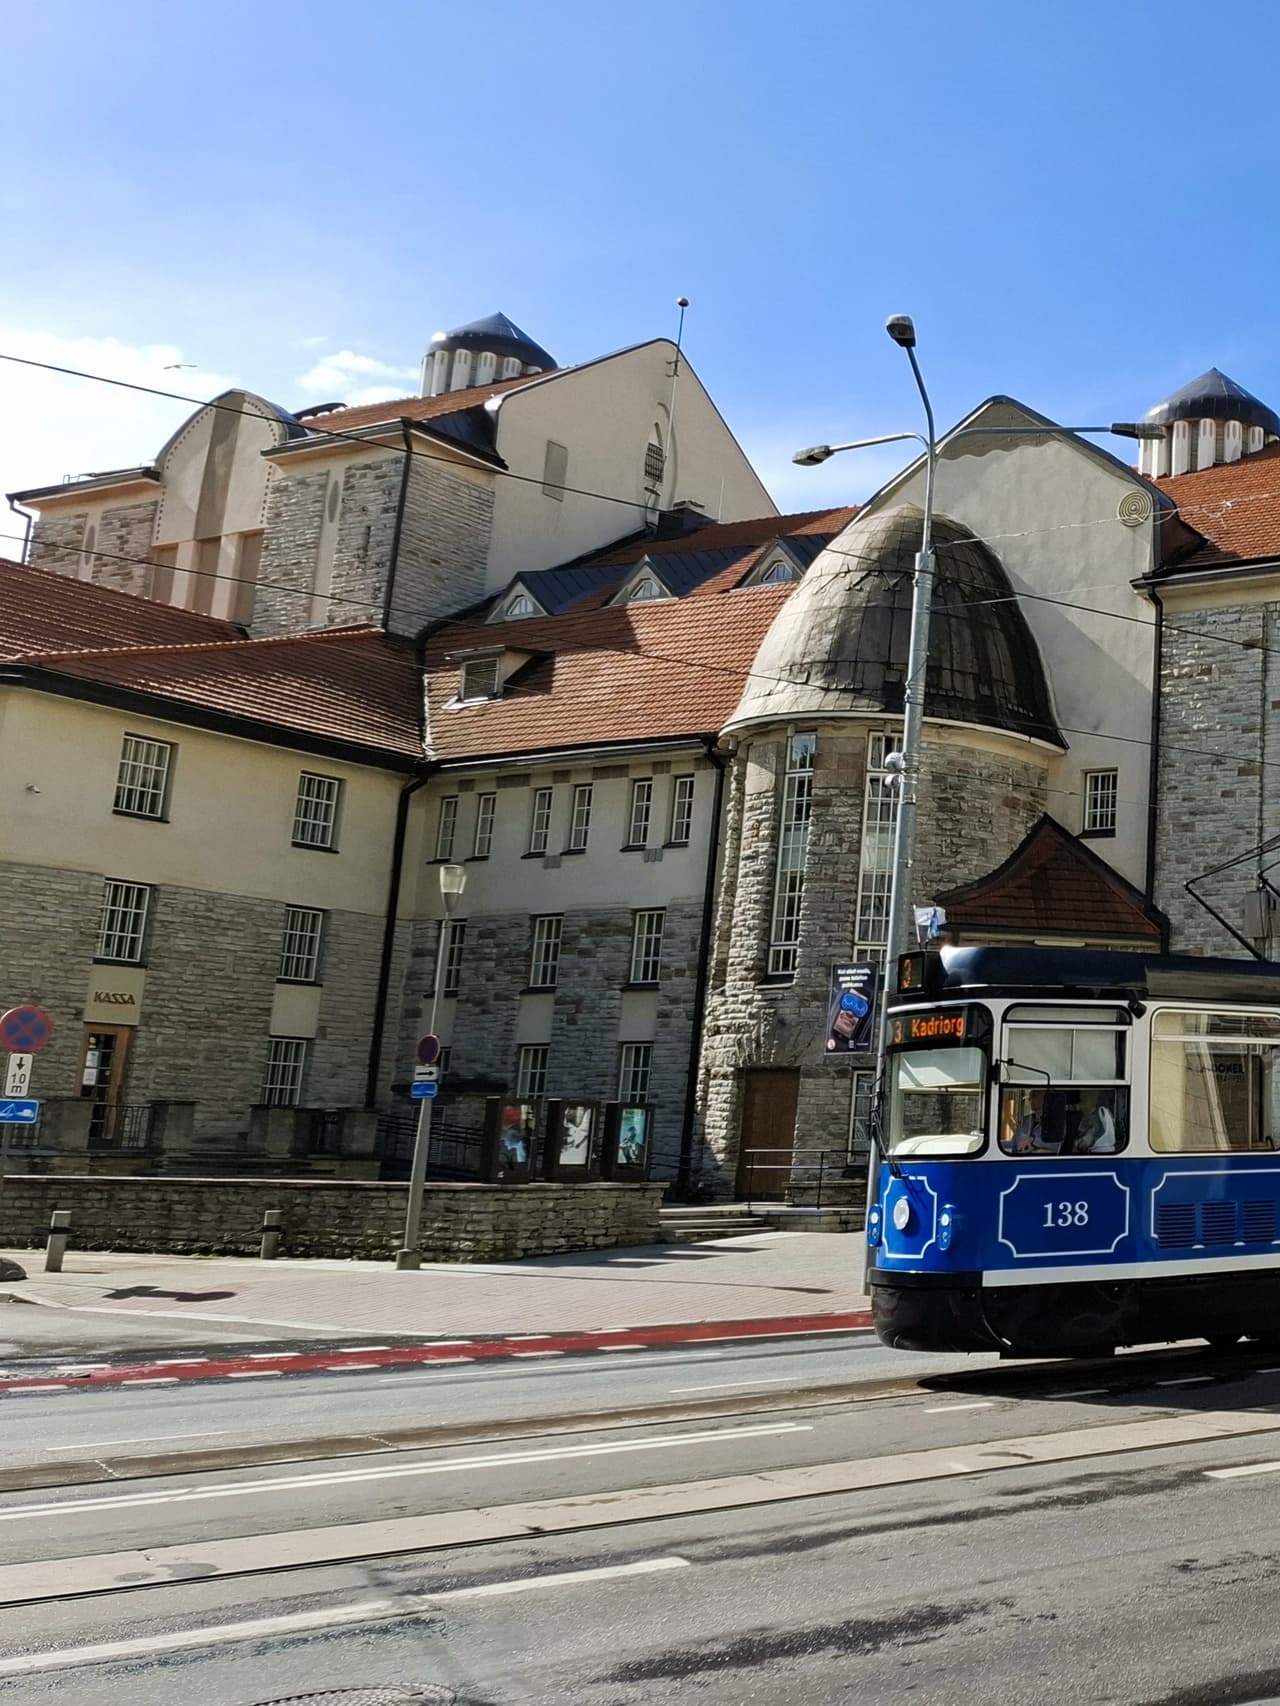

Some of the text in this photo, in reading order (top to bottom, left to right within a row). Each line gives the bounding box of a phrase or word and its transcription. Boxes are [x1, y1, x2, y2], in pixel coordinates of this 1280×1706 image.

[93, 991, 135, 1006] KASSA
[894, 1015, 965, 1043] 3 Kadriorg
[11, 1073, 26, 1084] 10
[11, 1085, 22, 1094] m
[1043, 1201, 1089, 1227] 138
